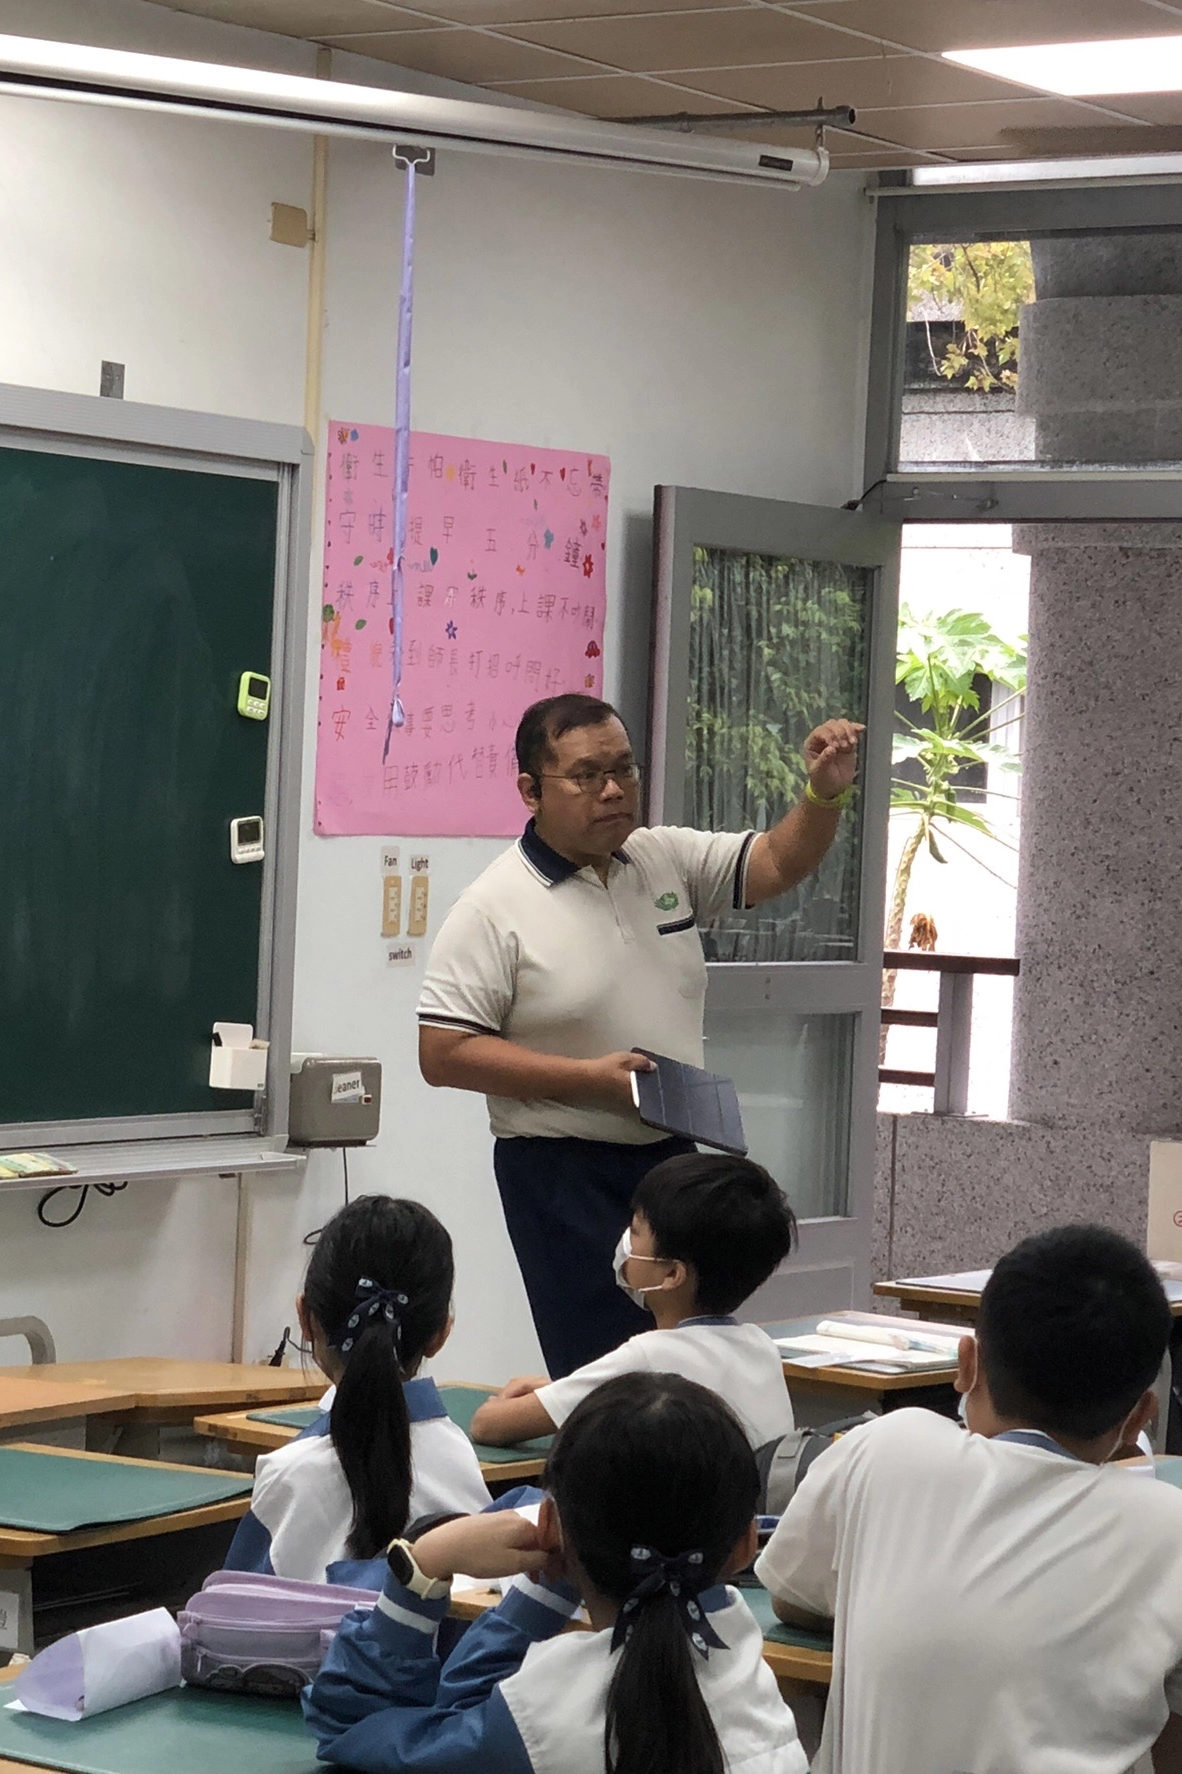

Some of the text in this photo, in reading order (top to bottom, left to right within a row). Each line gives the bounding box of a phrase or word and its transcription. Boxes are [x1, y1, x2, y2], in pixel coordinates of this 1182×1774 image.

[384, 855, 398, 867] Fan
[411, 857, 429, 872] Light
[388, 947, 412, 961] switch
